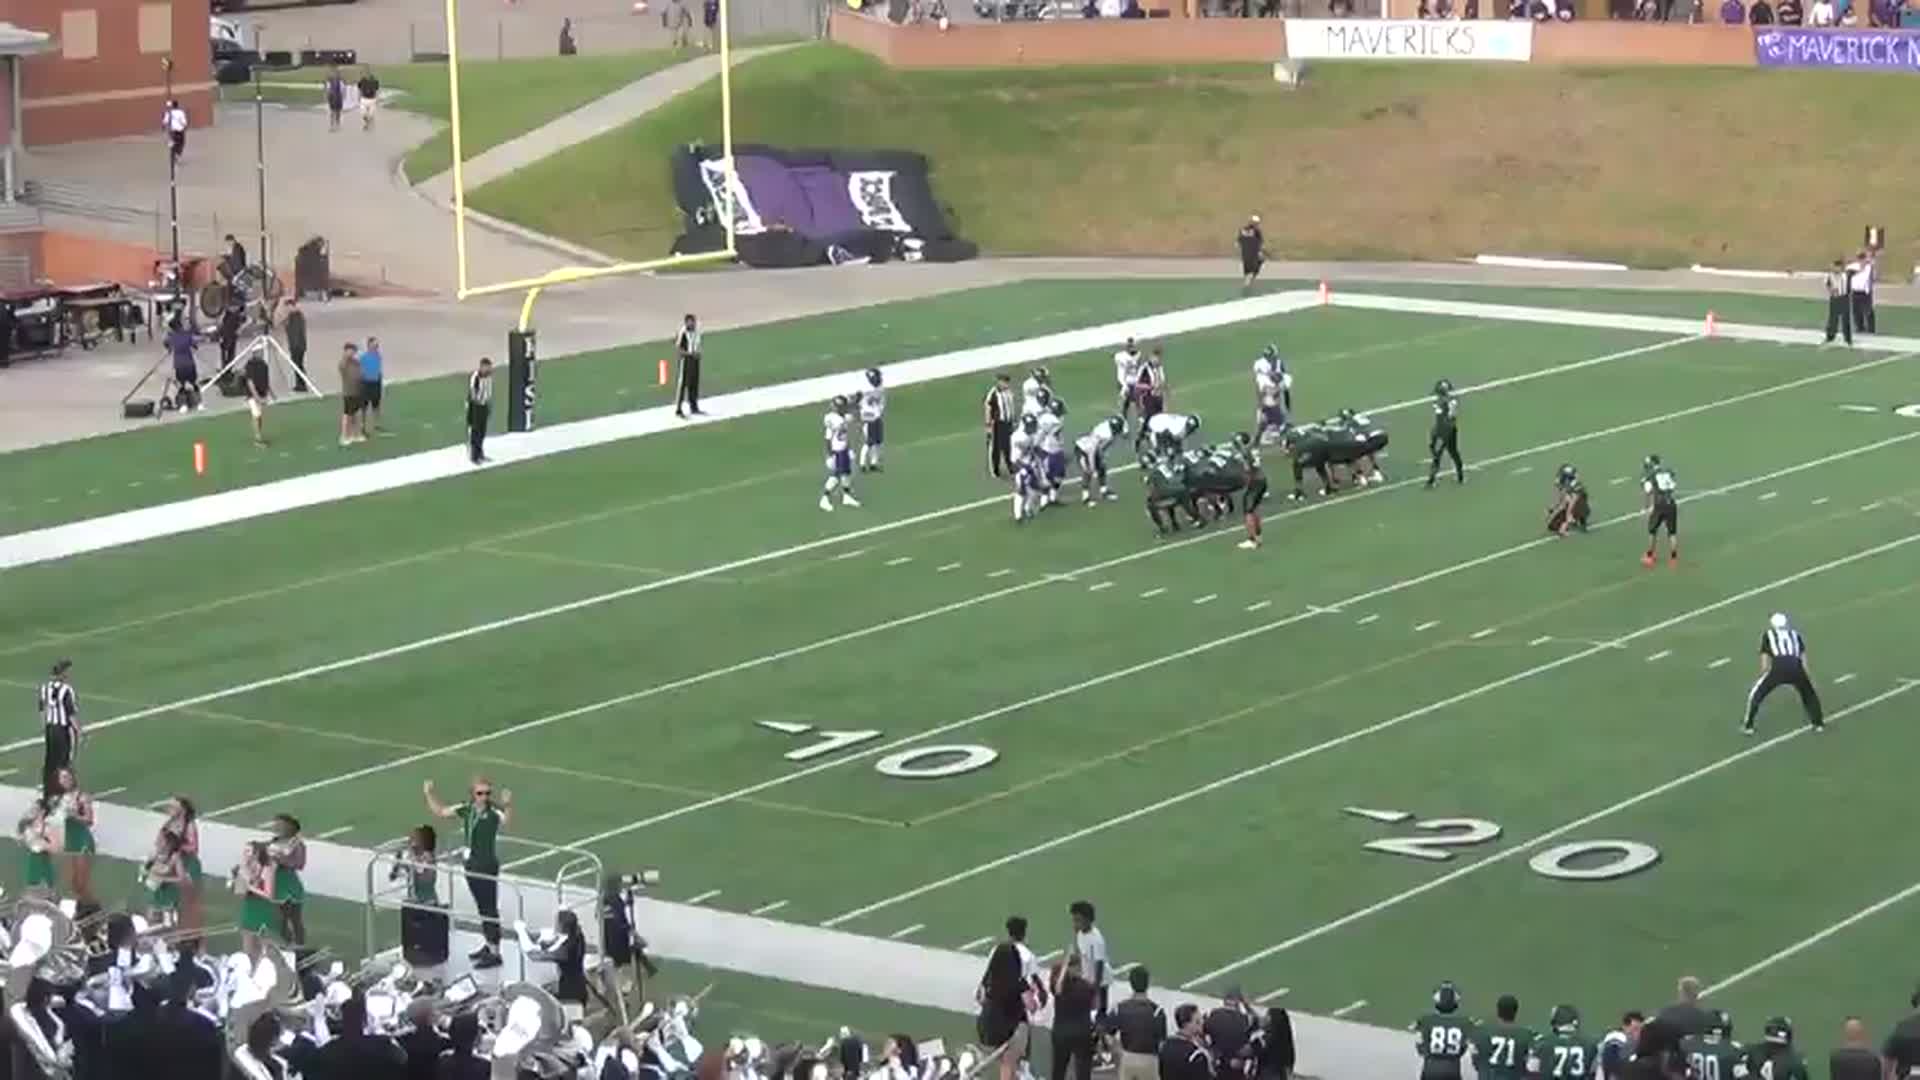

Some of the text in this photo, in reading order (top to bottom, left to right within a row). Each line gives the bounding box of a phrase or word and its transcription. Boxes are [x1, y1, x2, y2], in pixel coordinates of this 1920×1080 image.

[1326, 25, 1476, 55] MAVERICKS
[1788, 34, 1900, 65] MAVERICK
[1429, 1026, 1463, 1055] 89
[1488, 1035, 1516, 1067] 71
[1553, 1046, 1586, 1077] 73
